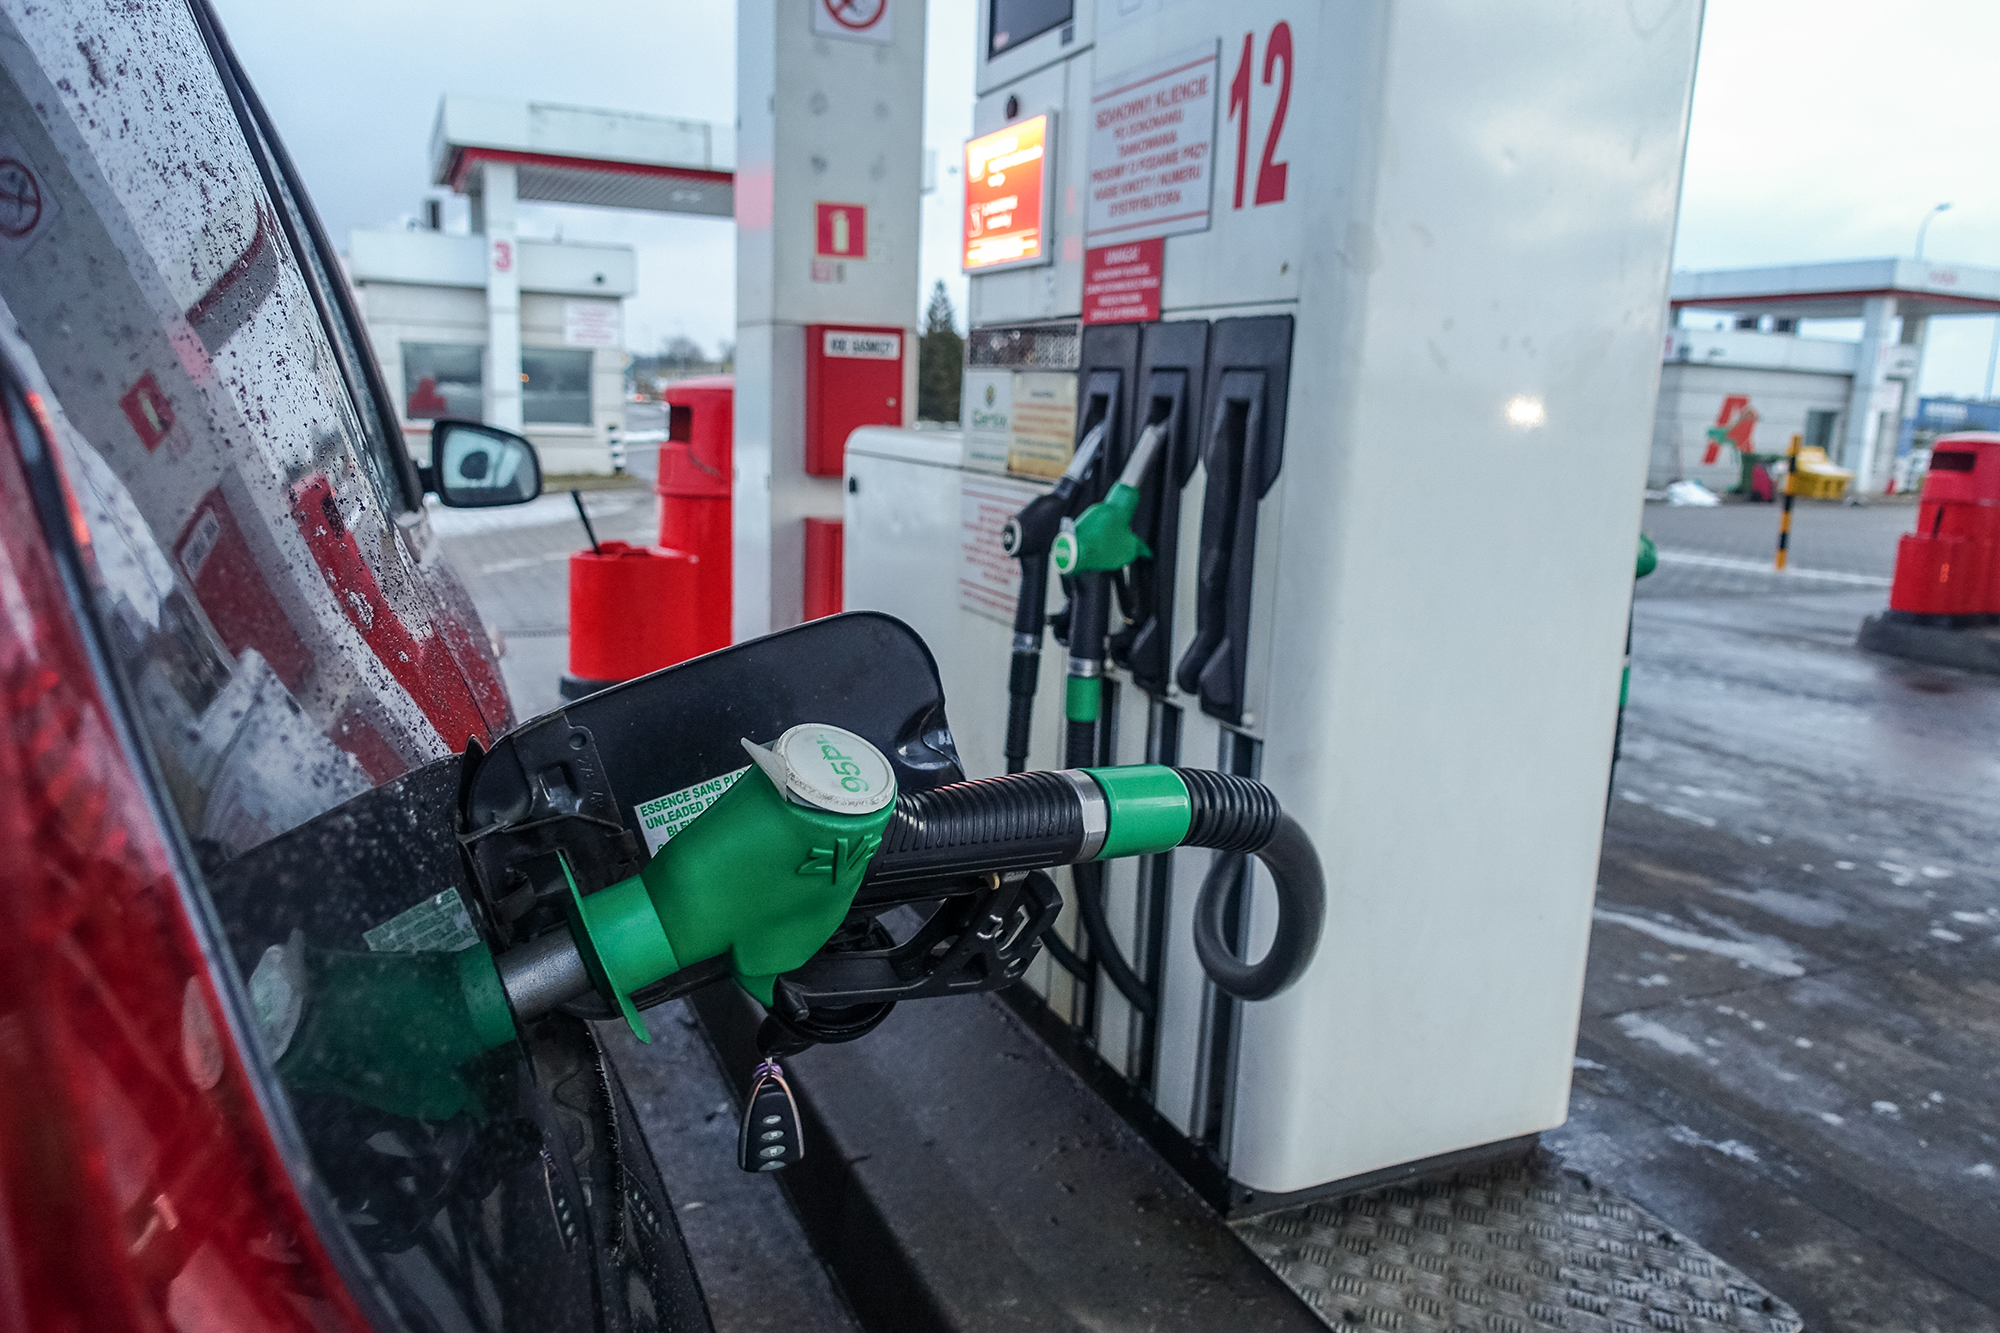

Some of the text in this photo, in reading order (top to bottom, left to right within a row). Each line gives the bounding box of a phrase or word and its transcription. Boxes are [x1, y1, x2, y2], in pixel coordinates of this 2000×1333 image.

[1228, 19, 1294, 211] 12
[495, 240, 512, 272] 3
[640, 790, 691, 817] ESSENCE
[692, 780, 722, 799] SANS
[645, 801, 704, 830] UNLEADED
